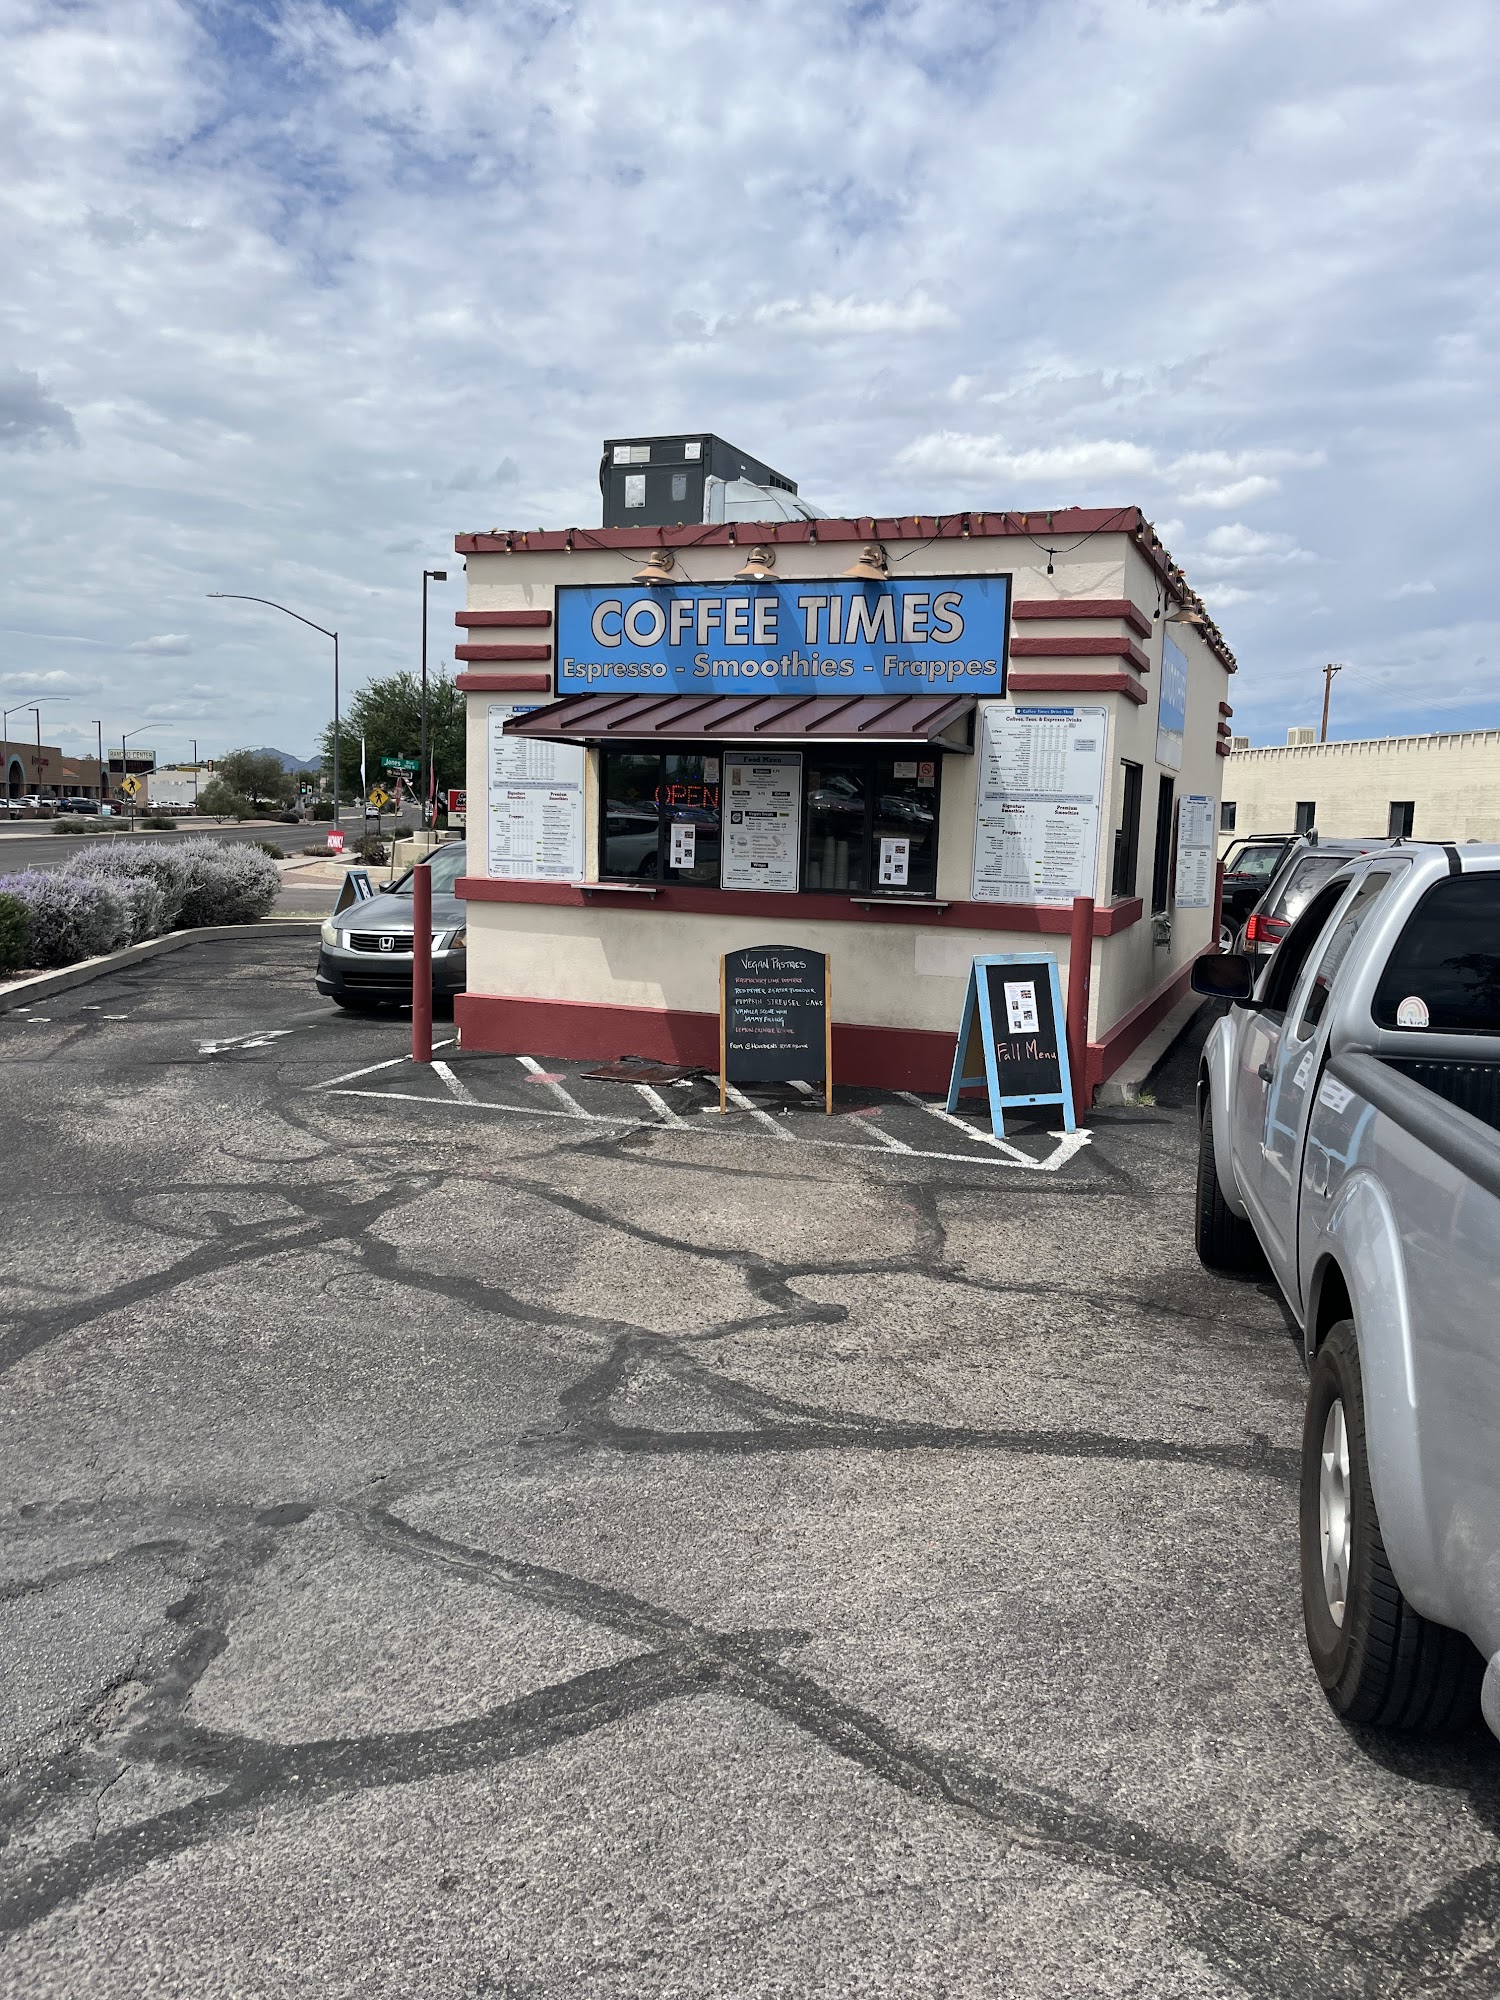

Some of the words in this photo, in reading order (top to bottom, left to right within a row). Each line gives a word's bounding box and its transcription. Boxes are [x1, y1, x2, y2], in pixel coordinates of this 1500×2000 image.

[590, 597, 779, 648] COFFEE
[798, 592, 965, 645] TIMES
[563, 658, 668, 684] Espresso
[693, 650, 855, 680] Smoothies
[883, 654, 998, 682] Frappes
[132, 751, 153, 759] CENTER
[384, 758, 401, 766] Jones
[654, 784, 719, 808] OPEN
[767, 998, 801, 1007] STREUSEL
[1399, 1017, 1407, 1025] be
[1409, 1018, 1428, 1026] kind
[997, 1042, 1021, 1062] Fall
[1025, 1038, 1057, 1061] Menu
